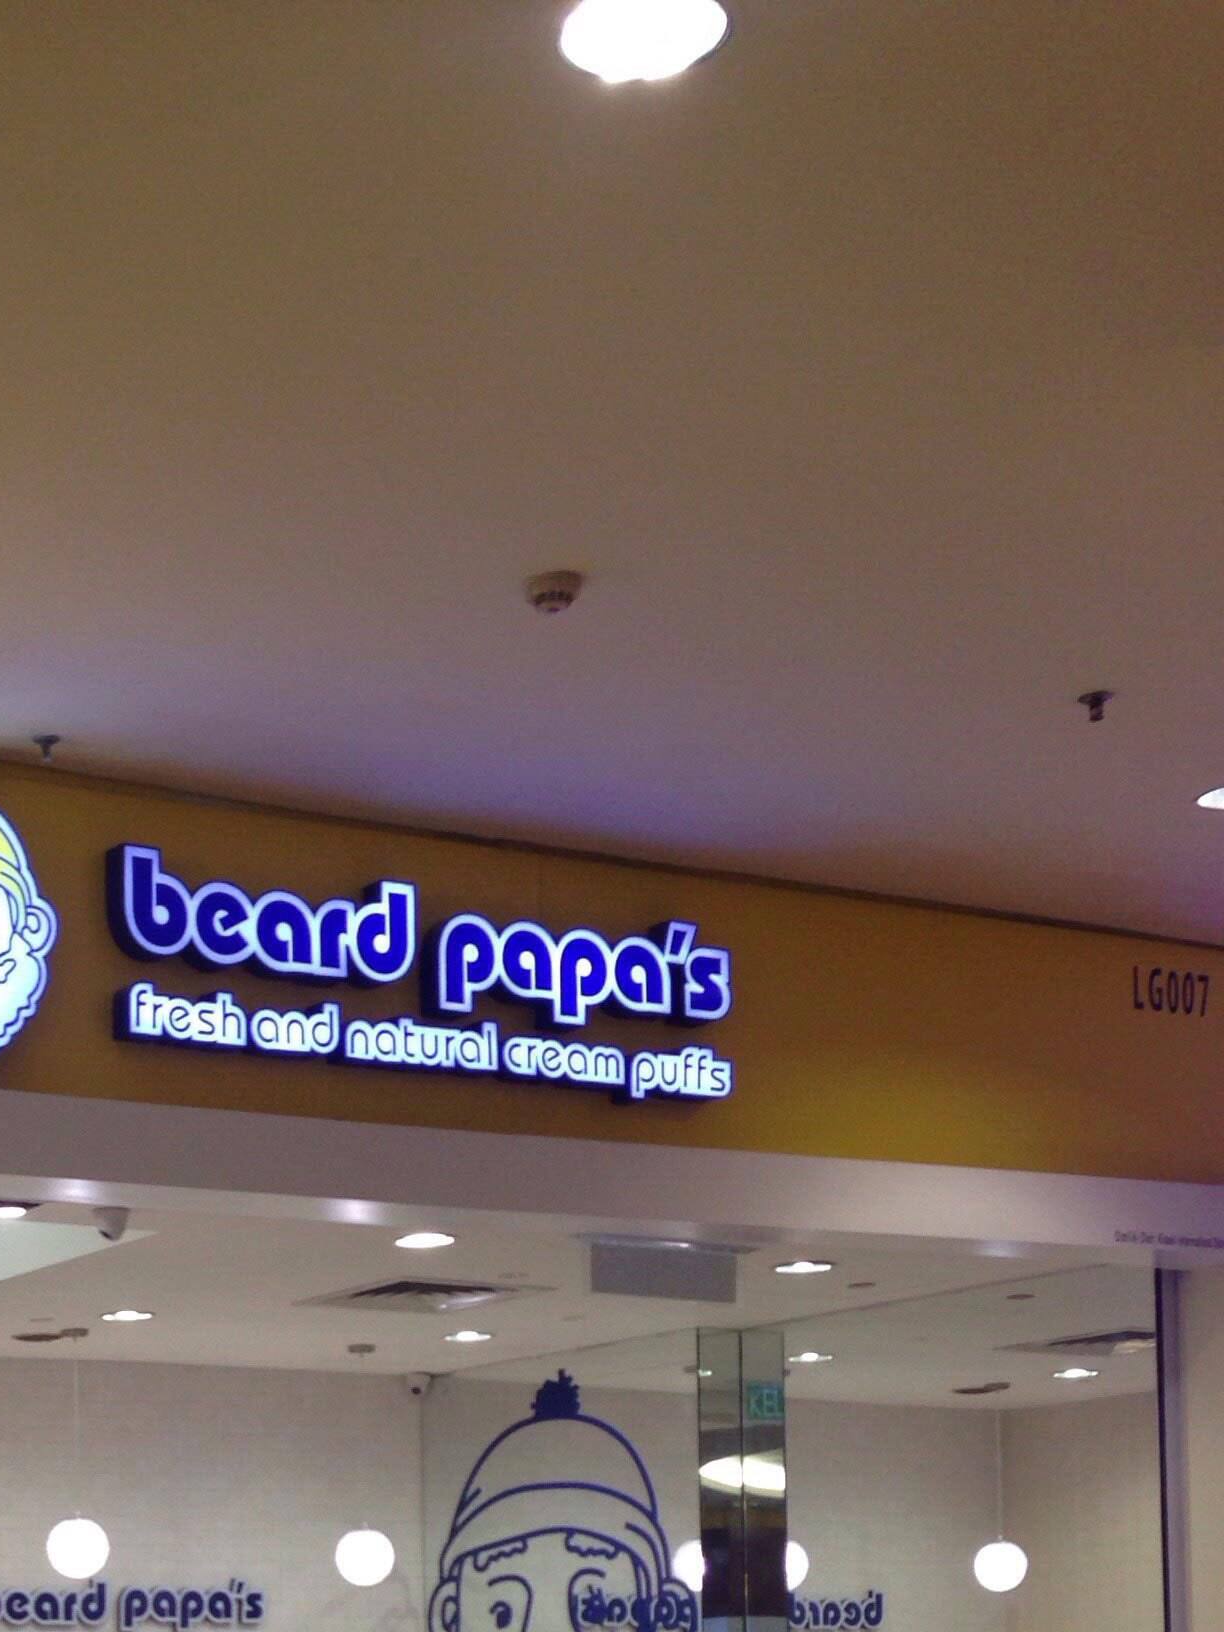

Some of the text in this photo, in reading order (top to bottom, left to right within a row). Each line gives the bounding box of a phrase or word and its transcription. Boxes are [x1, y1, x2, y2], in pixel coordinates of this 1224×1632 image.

[126, 849, 729, 1022] beard papa's
[1132, 966, 1210, 1018] LG007
[132, 986, 730, 1096] fresh and natural cream puffs
[122, 1581, 264, 1629] papa's
